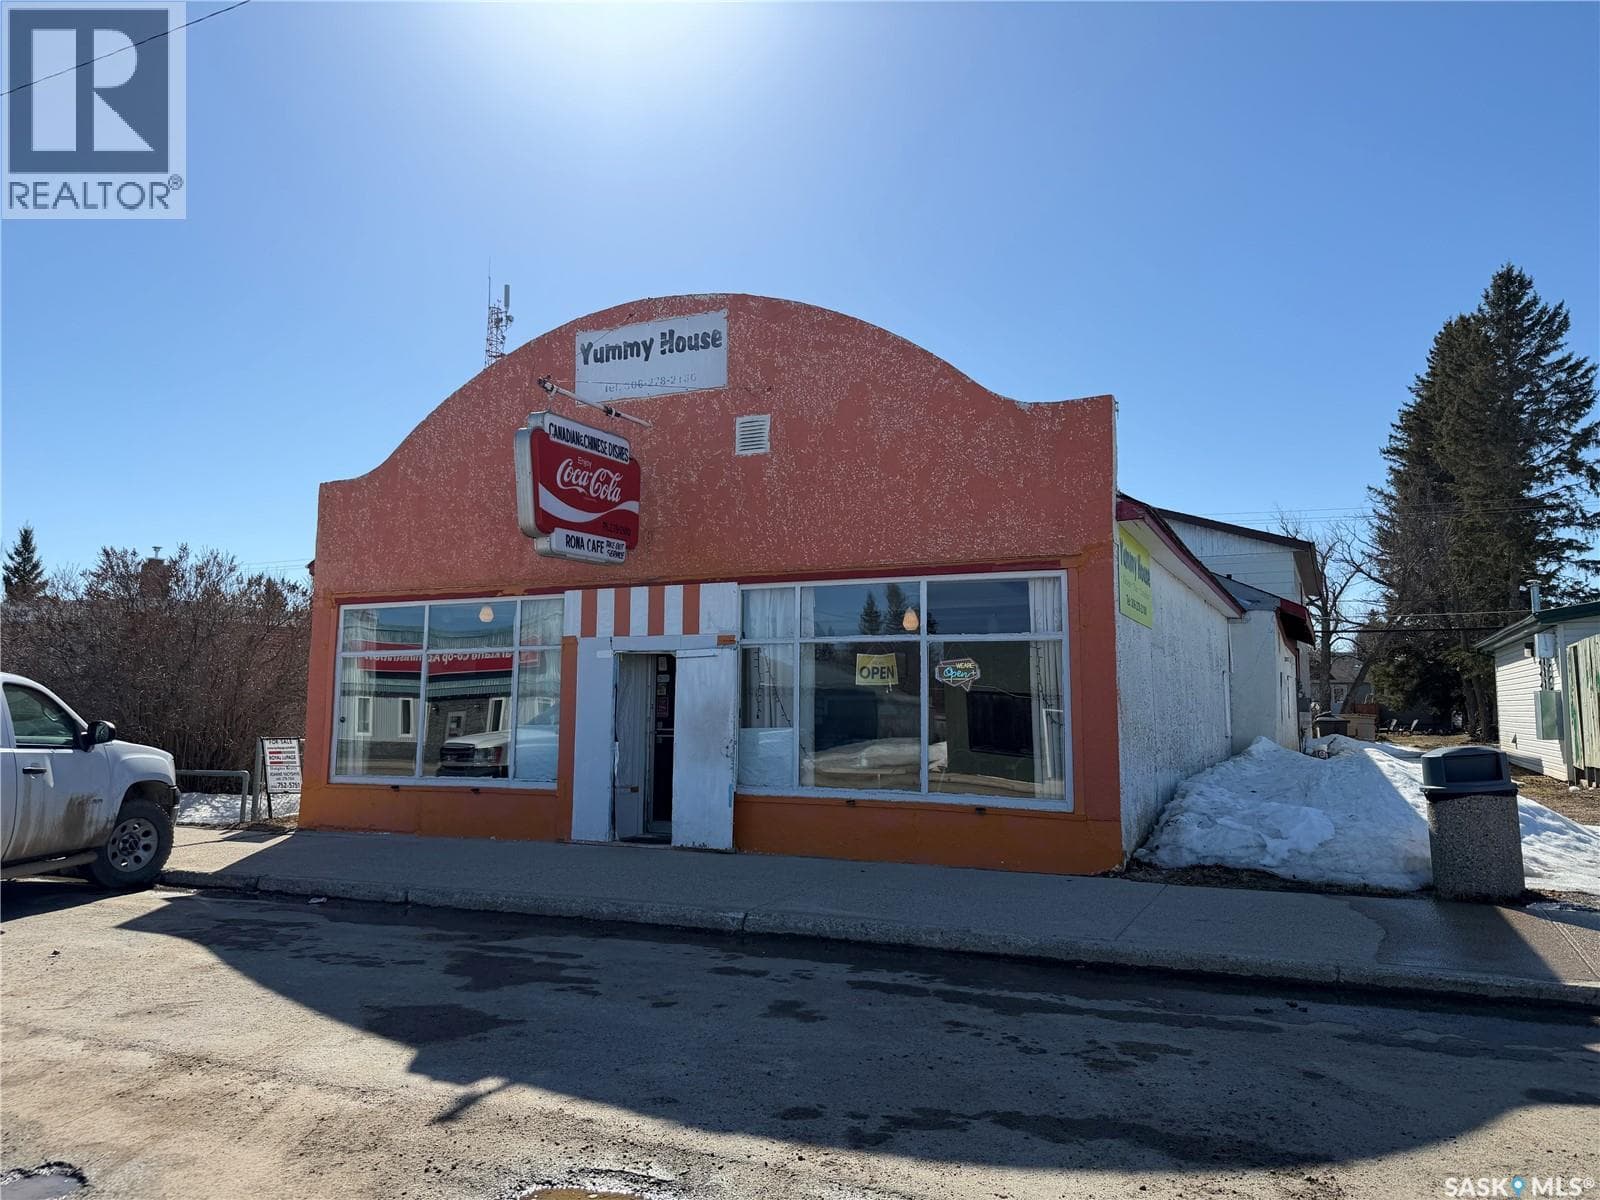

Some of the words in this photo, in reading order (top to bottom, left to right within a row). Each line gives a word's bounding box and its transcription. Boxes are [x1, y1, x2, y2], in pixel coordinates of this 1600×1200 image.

[580, 337, 654, 365] Yummy
[660, 329, 722, 355] House
[608, 442, 629, 462] DISHES
[556, 458, 623, 502] Coca-Cola
[586, 538, 605, 554] CAFE
[860, 665, 894, 680] OPEN
[944, 666, 973, 684] Open
